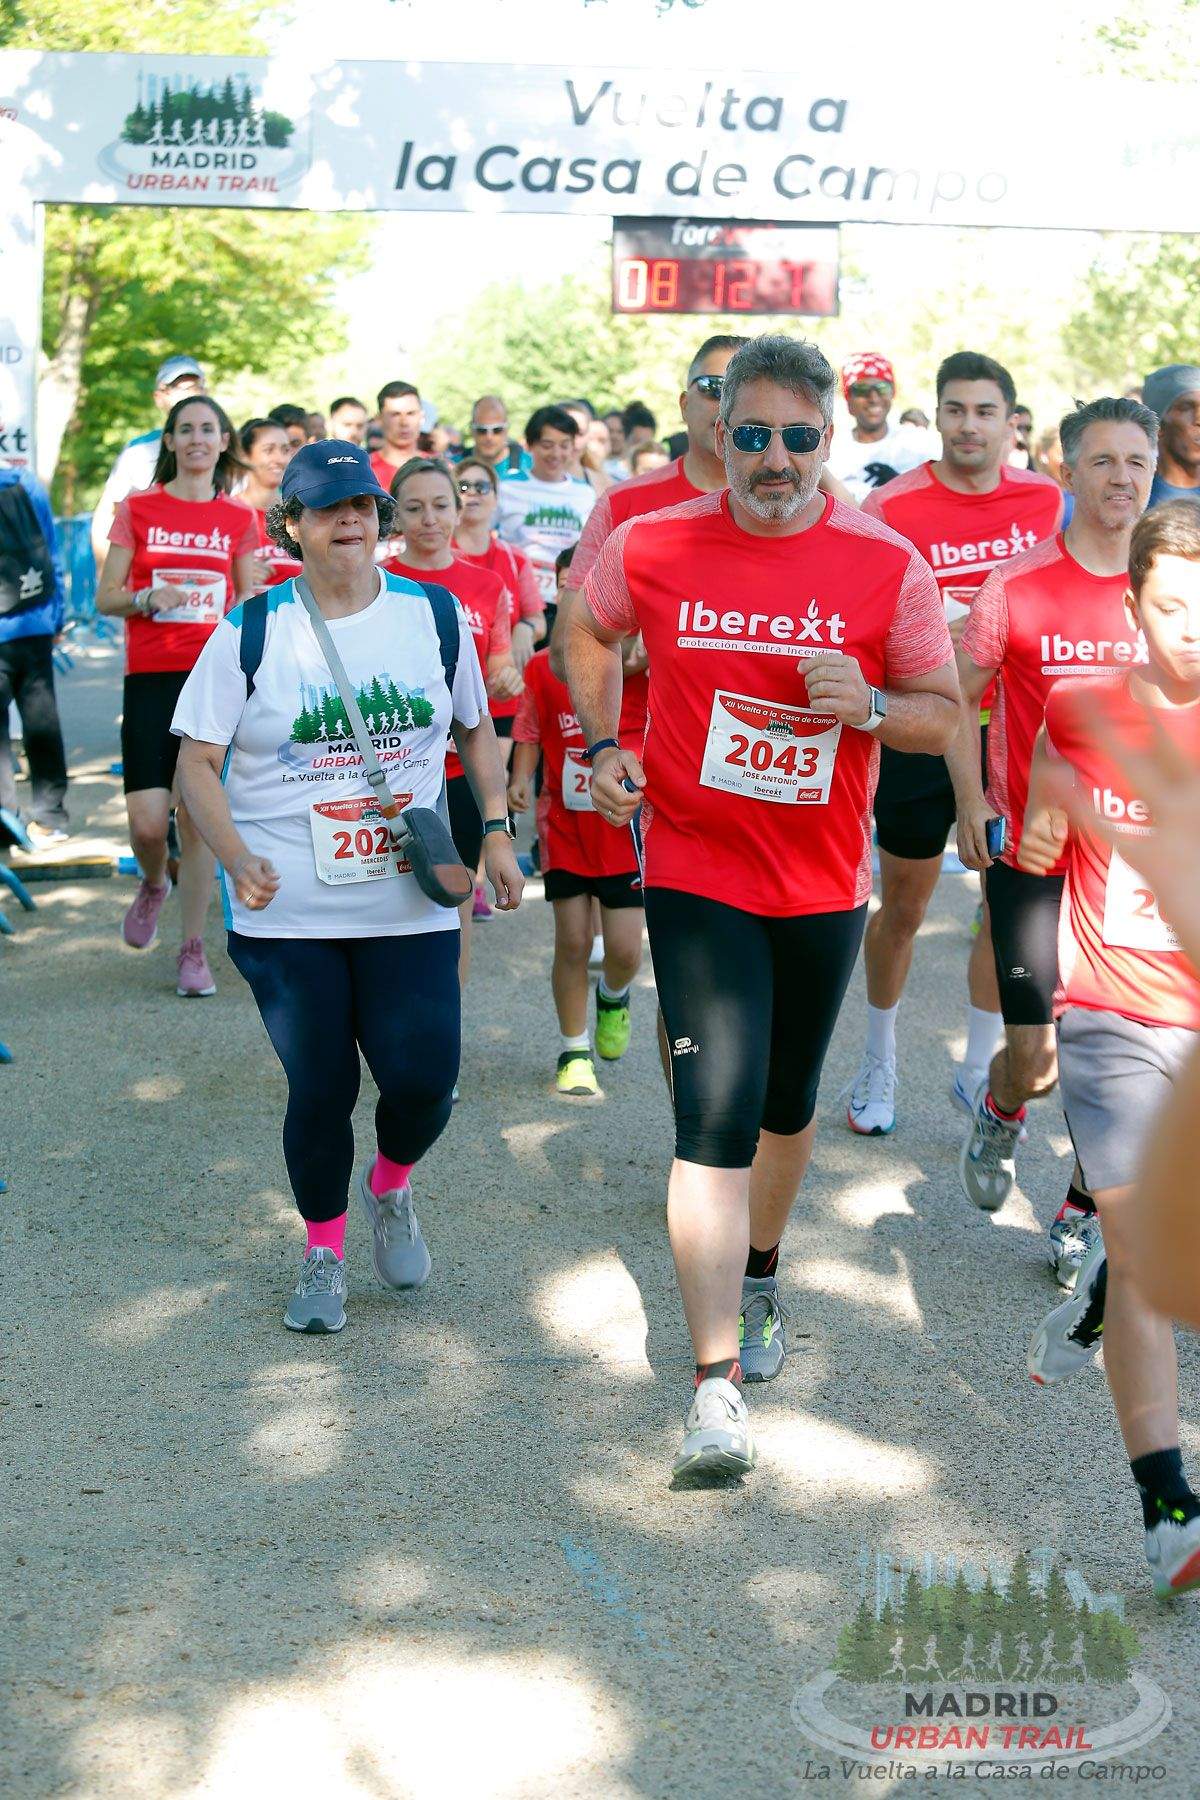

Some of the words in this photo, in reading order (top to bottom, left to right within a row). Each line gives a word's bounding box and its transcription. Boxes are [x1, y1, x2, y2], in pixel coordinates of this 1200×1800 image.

[565, 78, 783, 132] Vuelta
[808, 97, 848, 133] a
[151, 151, 258, 171] MADRID
[127, 172, 209, 192] URBAN
[219, 174, 280, 193] TRAIL
[394, 141, 457, 190] la
[475, 145, 641, 195] Casa
[666, 150, 748, 198] de
[773, 153, 1009, 213] Campo
[147, 526, 232, 551] Iberext
[931, 522, 1038, 567] Iberext
[677, 599, 847, 645] Iberext
[678, 638, 739, 651] Protección
[742, 641, 782, 655] Contra
[787, 645, 834, 658] Incend
[1040, 627, 1150, 665] Iberex
[725, 700, 736, 708] XII
[736, 701, 762, 715] Vuelta
[769, 710, 778, 718] la
[780, 713, 801, 722] Casa
[801, 716, 812, 724] de
[812, 717, 837, 725] Campo
[328, 736, 402, 754] MARID
[725, 734, 820, 778] 2043
[282, 774, 295, 783] La
[298, 771, 335, 782] Vuelta
[348, 770, 358, 779] la
[718, 777, 743, 789] MADRID
[742, 771, 760, 780] JOSE
[760, 774, 798, 786] ANTONIO
[753, 785, 782, 796] Iberext
[330, 803, 353, 811] Vuelta
